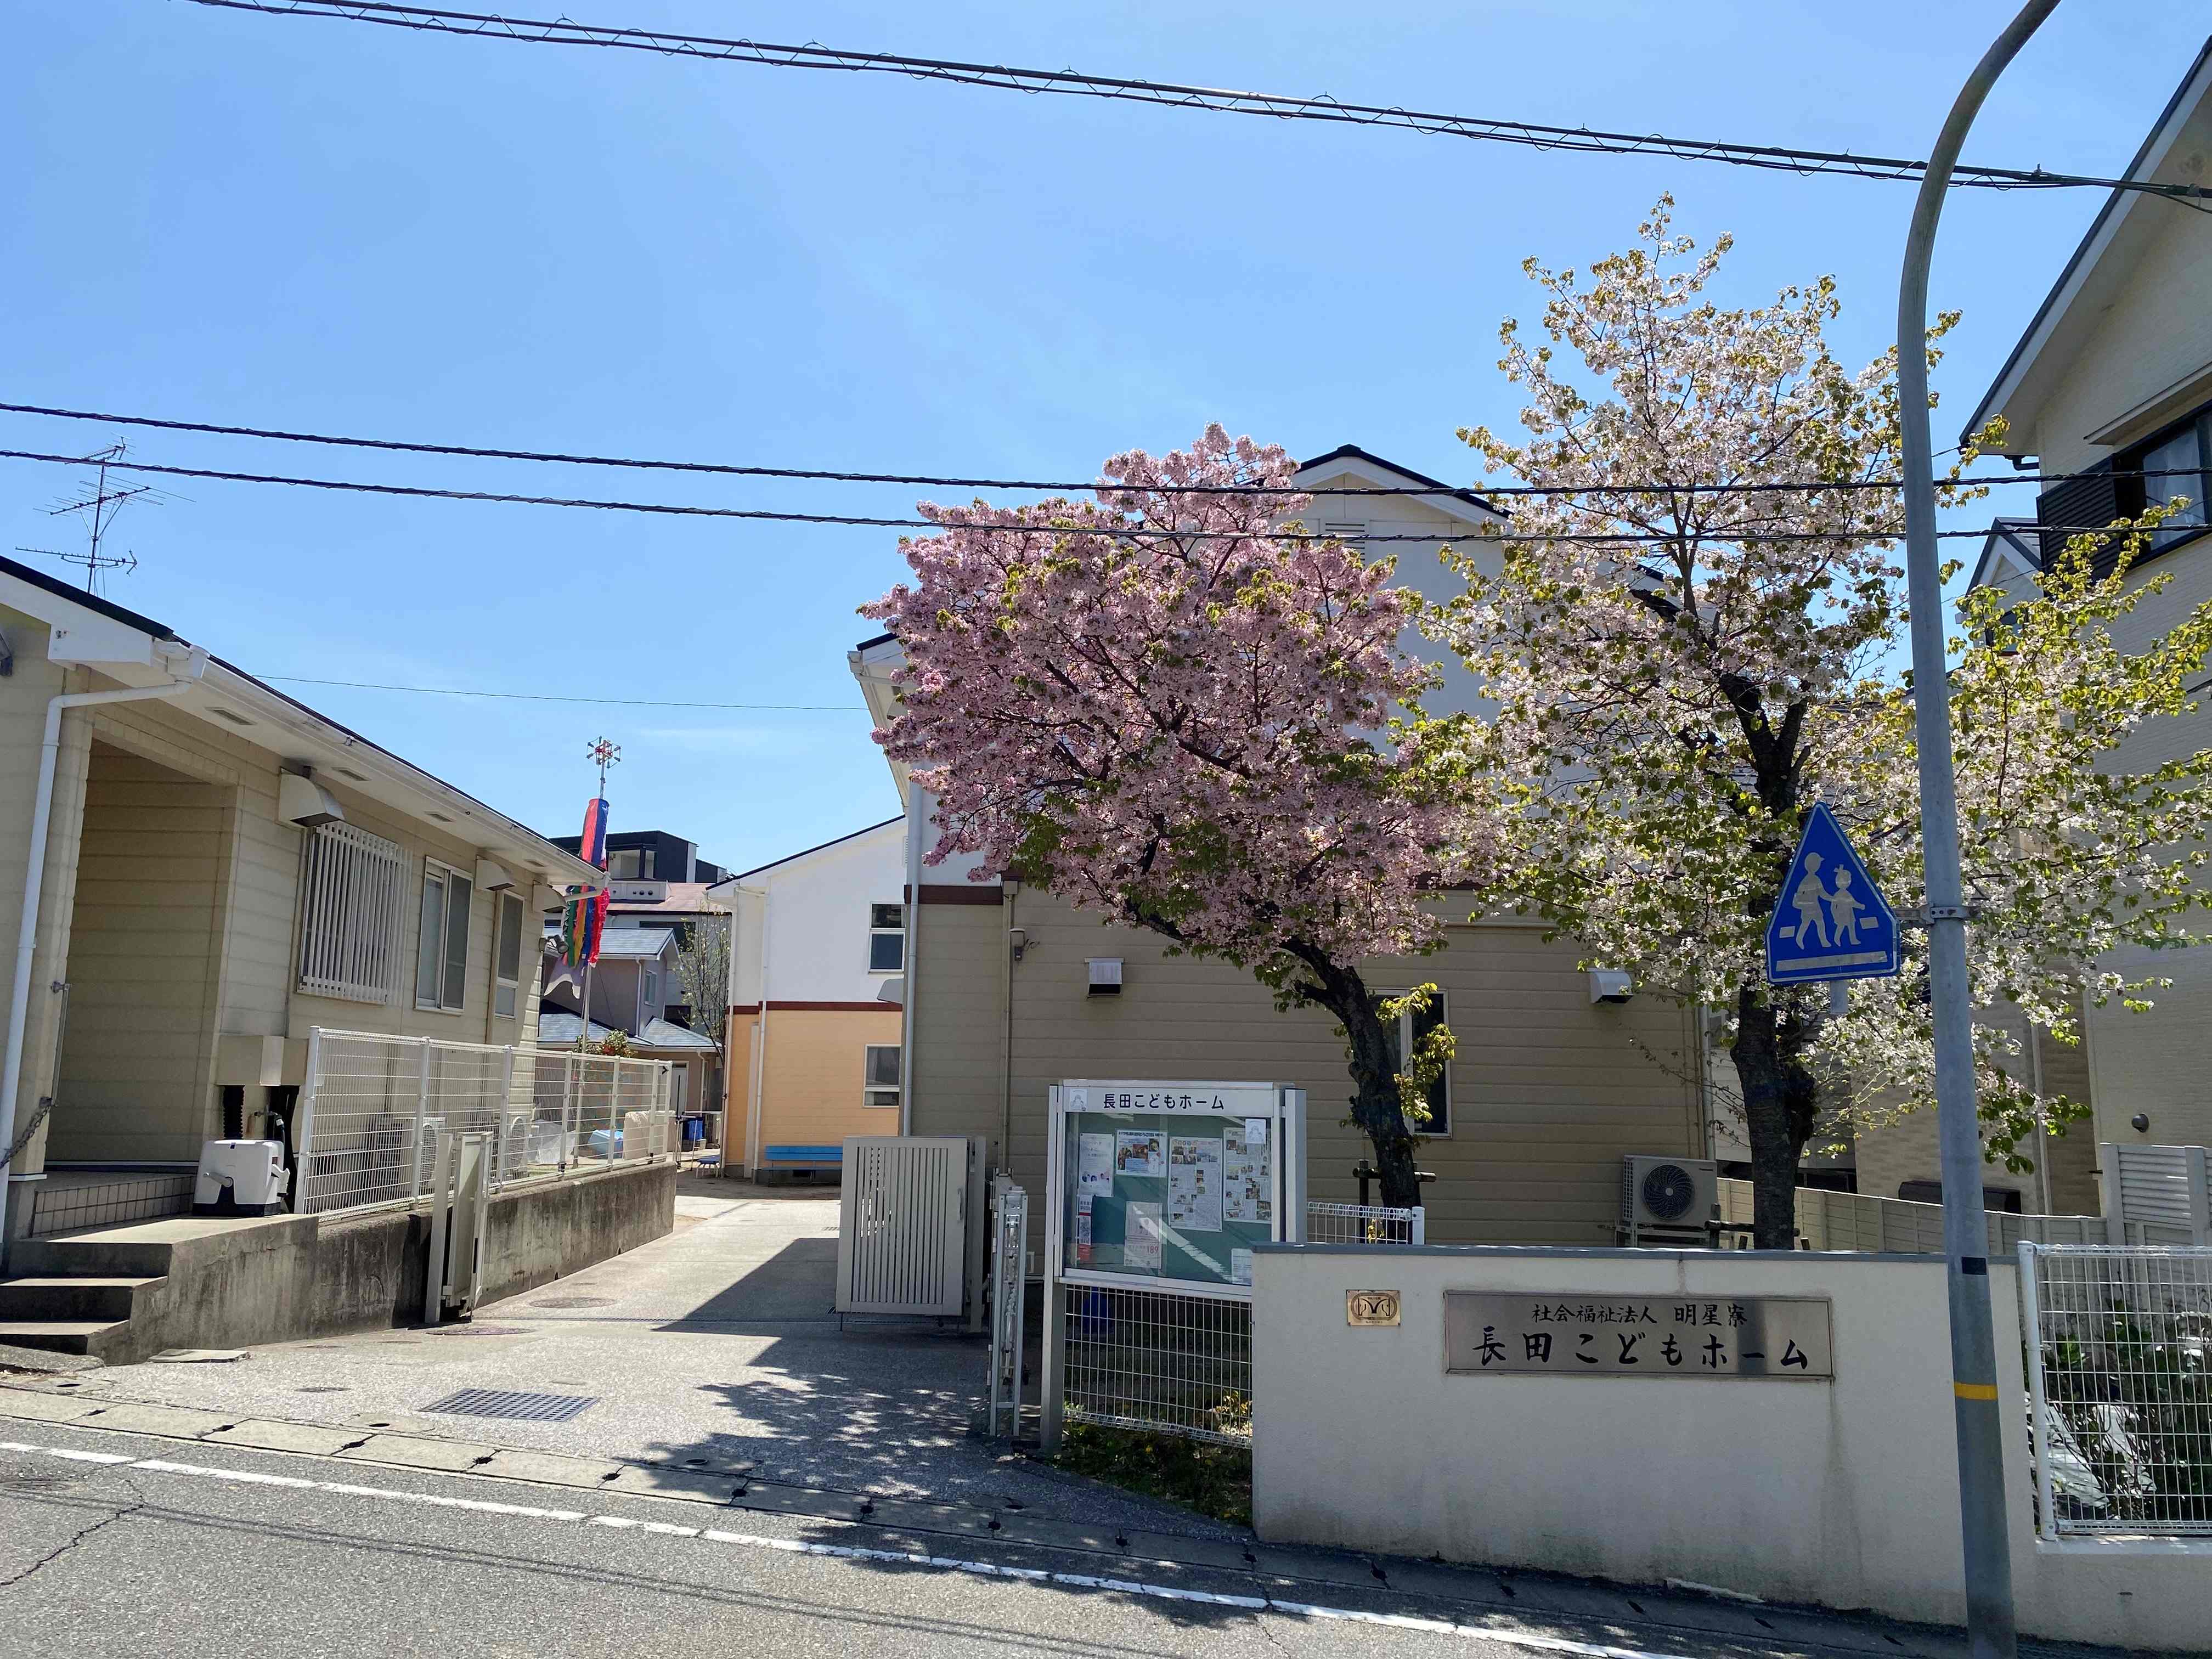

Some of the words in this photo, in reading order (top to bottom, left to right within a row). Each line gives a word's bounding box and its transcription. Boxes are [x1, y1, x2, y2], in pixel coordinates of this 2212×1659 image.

[1103, 1093, 1224, 1109] 長田こどもホーム
[1532, 1304, 1657, 1324] 社会福祉法人
[1674, 1303, 1747, 1328] 明星寮
[1472, 1325, 1808, 1370] 長田こどもホーム
